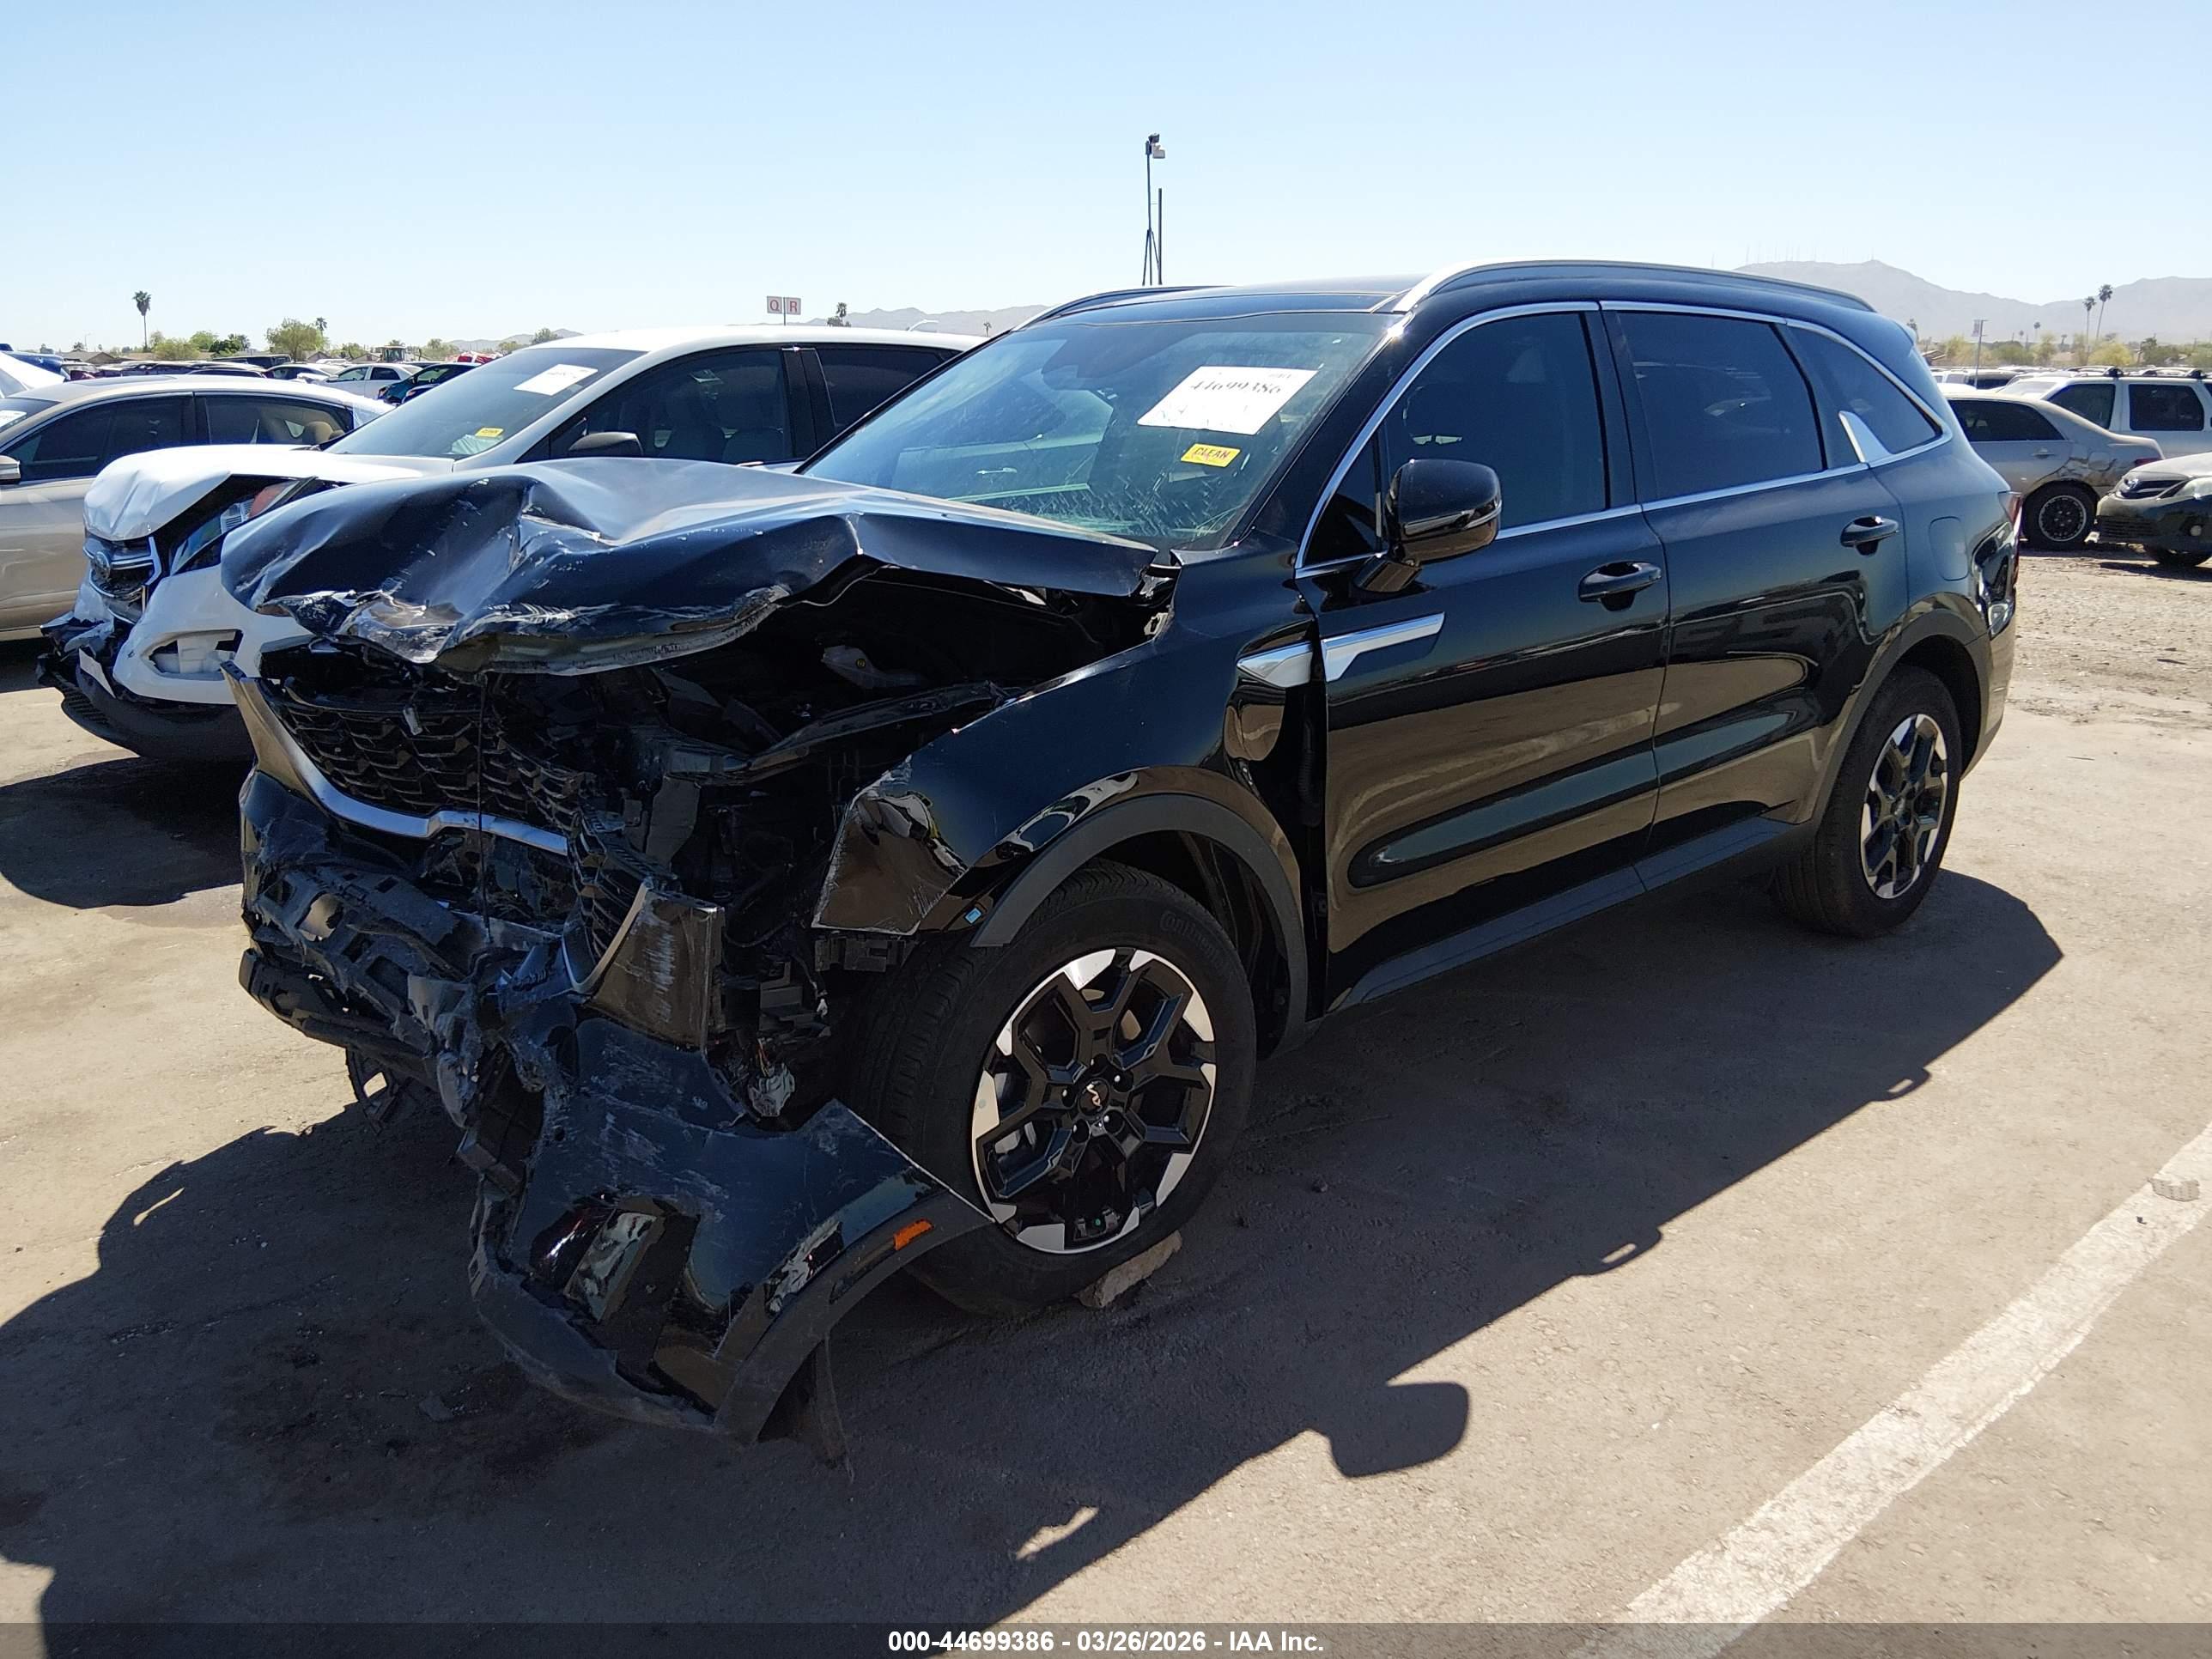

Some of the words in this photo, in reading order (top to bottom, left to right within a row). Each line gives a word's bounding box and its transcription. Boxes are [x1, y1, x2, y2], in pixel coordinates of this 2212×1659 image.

[769, 299, 780, 312] Q
[789, 301, 798, 313] R
[1194, 447, 1231, 459] CLEAN
